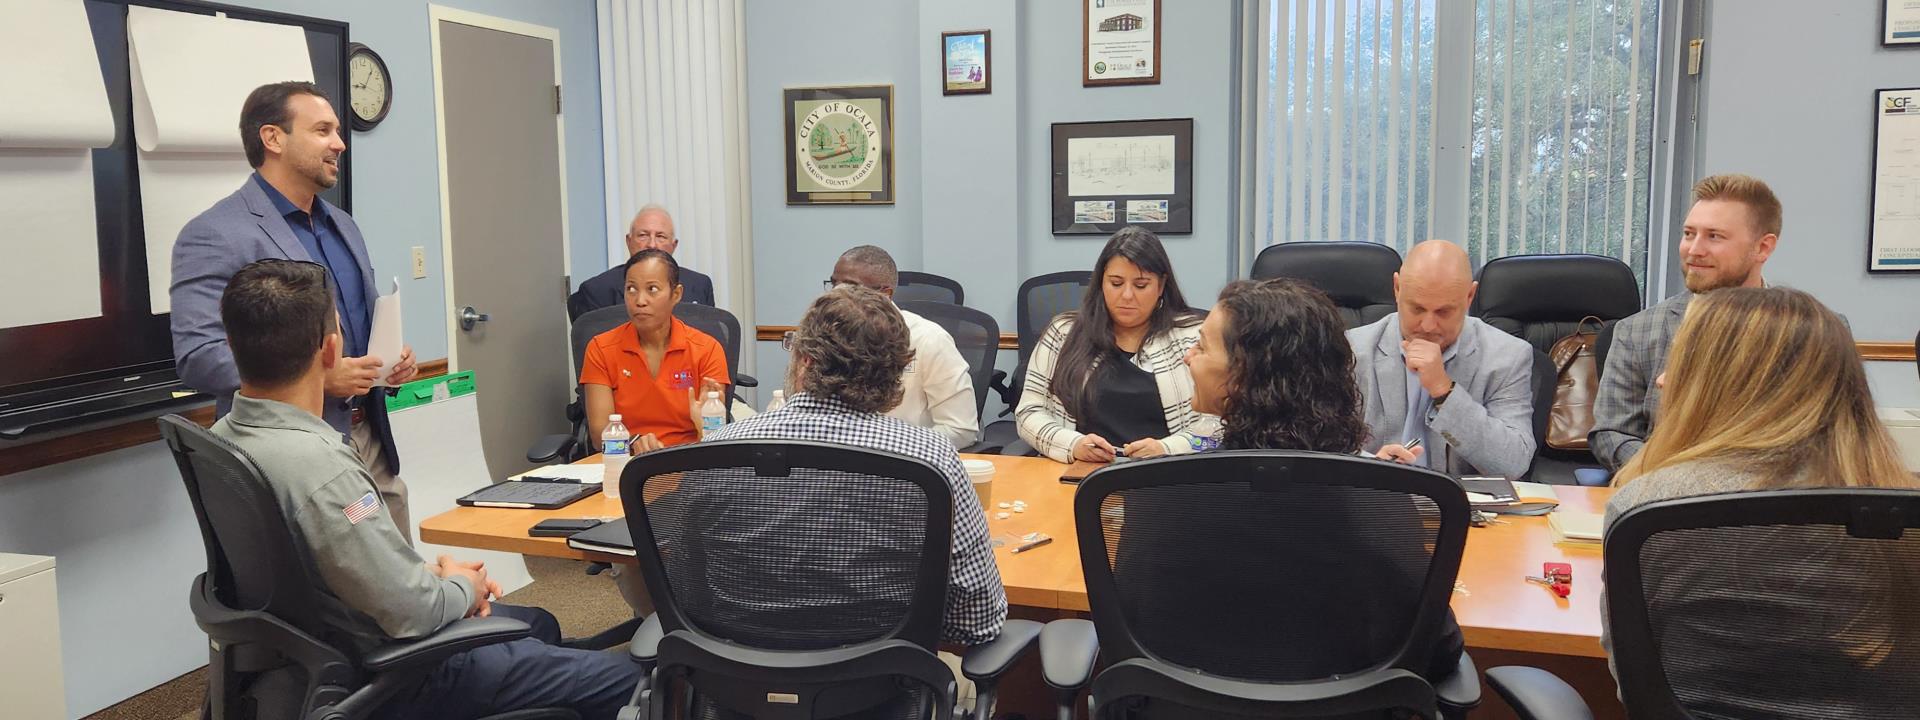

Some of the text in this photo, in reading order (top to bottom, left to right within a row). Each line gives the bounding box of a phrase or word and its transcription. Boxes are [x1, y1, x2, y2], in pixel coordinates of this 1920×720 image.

[800, 102, 876, 139] CITY OF OCALA
[806, 160, 824, 181] MARION
[852, 160, 874, 182] FLORIDA
